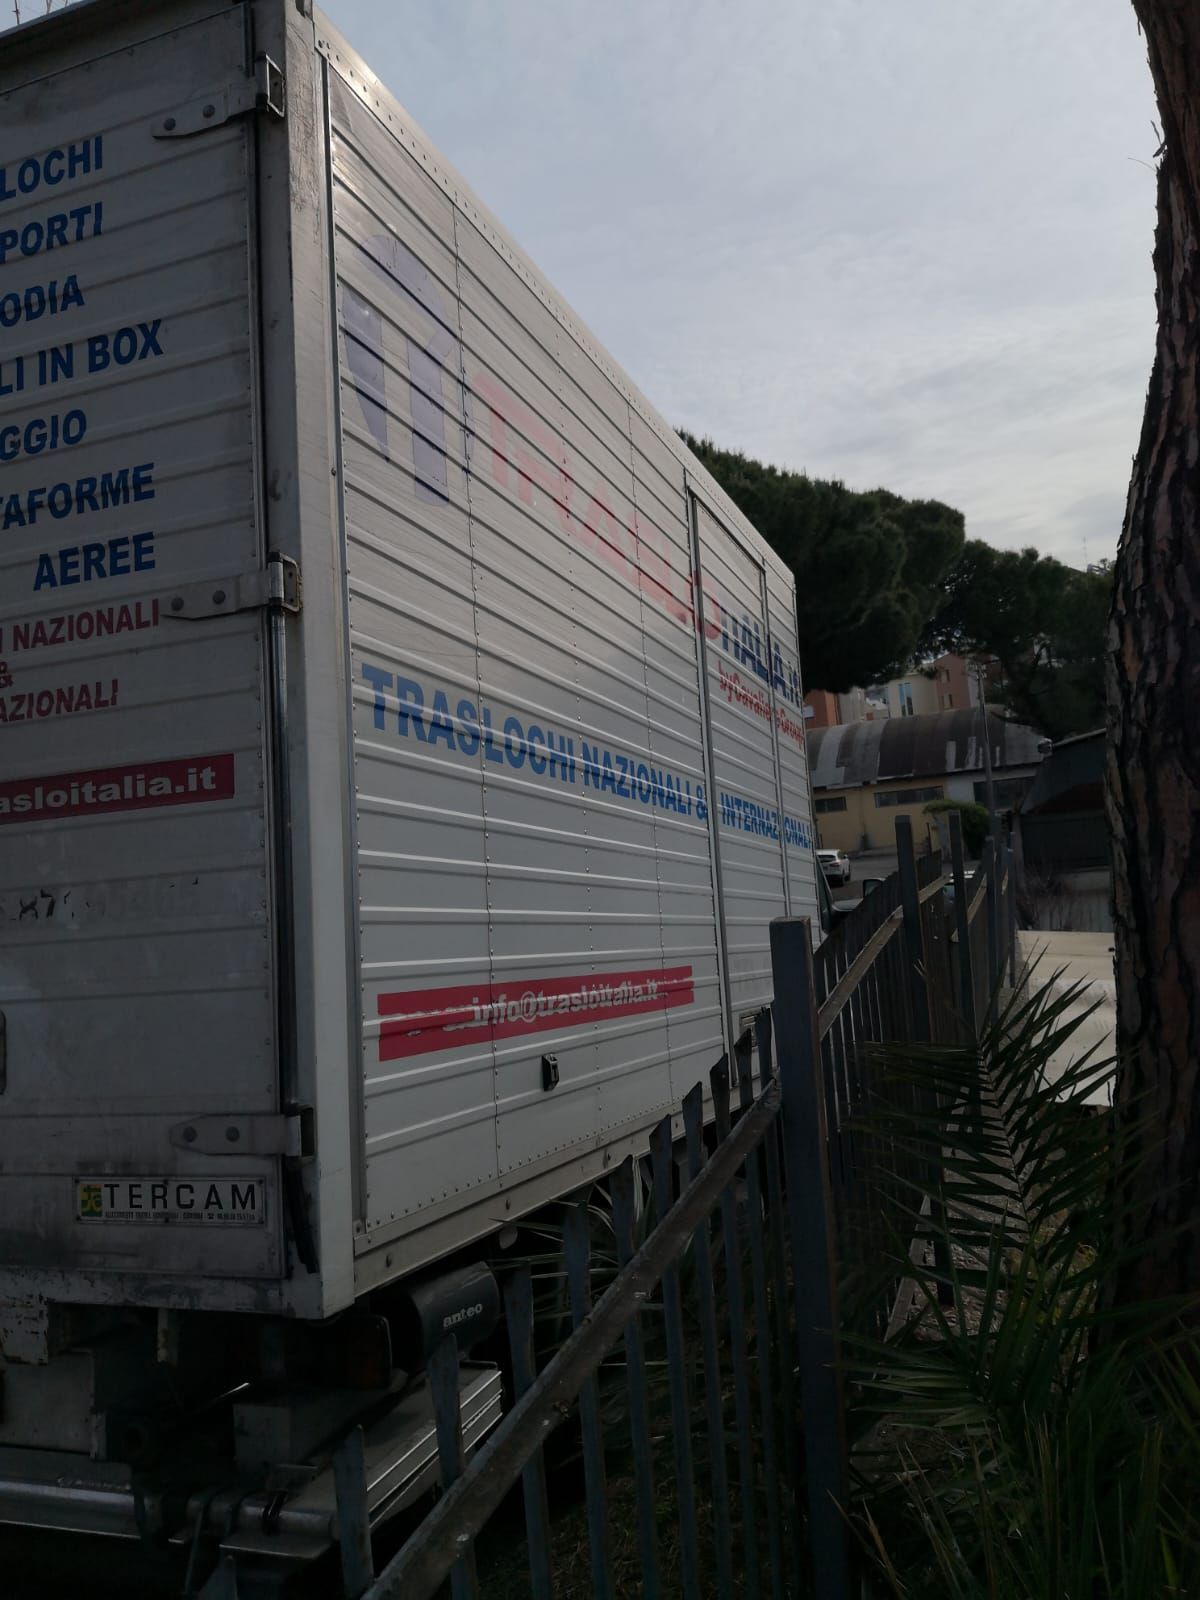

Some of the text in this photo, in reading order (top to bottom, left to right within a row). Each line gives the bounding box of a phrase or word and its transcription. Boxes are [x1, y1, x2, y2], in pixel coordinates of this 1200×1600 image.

[0, 135, 103, 200] LOCHI
[0, 202, 103, 264] PORTI
[0, 274, 85, 328] ODIA
[38, 342, 74, 386] IN
[87, 318, 163, 373] BOX
[0, 409, 87, 461] GGIO
[0, 462, 156, 530] AFORME
[33, 531, 156, 592] AEREE
[13, 598, 159, 651] NAZIONALI
[361, 662, 576, 783] TRASLOCHI
[582, 741, 692, 817] NAZIONALI
[104, 1183, 256, 1210] TERCAM
[443, 1303, 483, 1328] anteo
